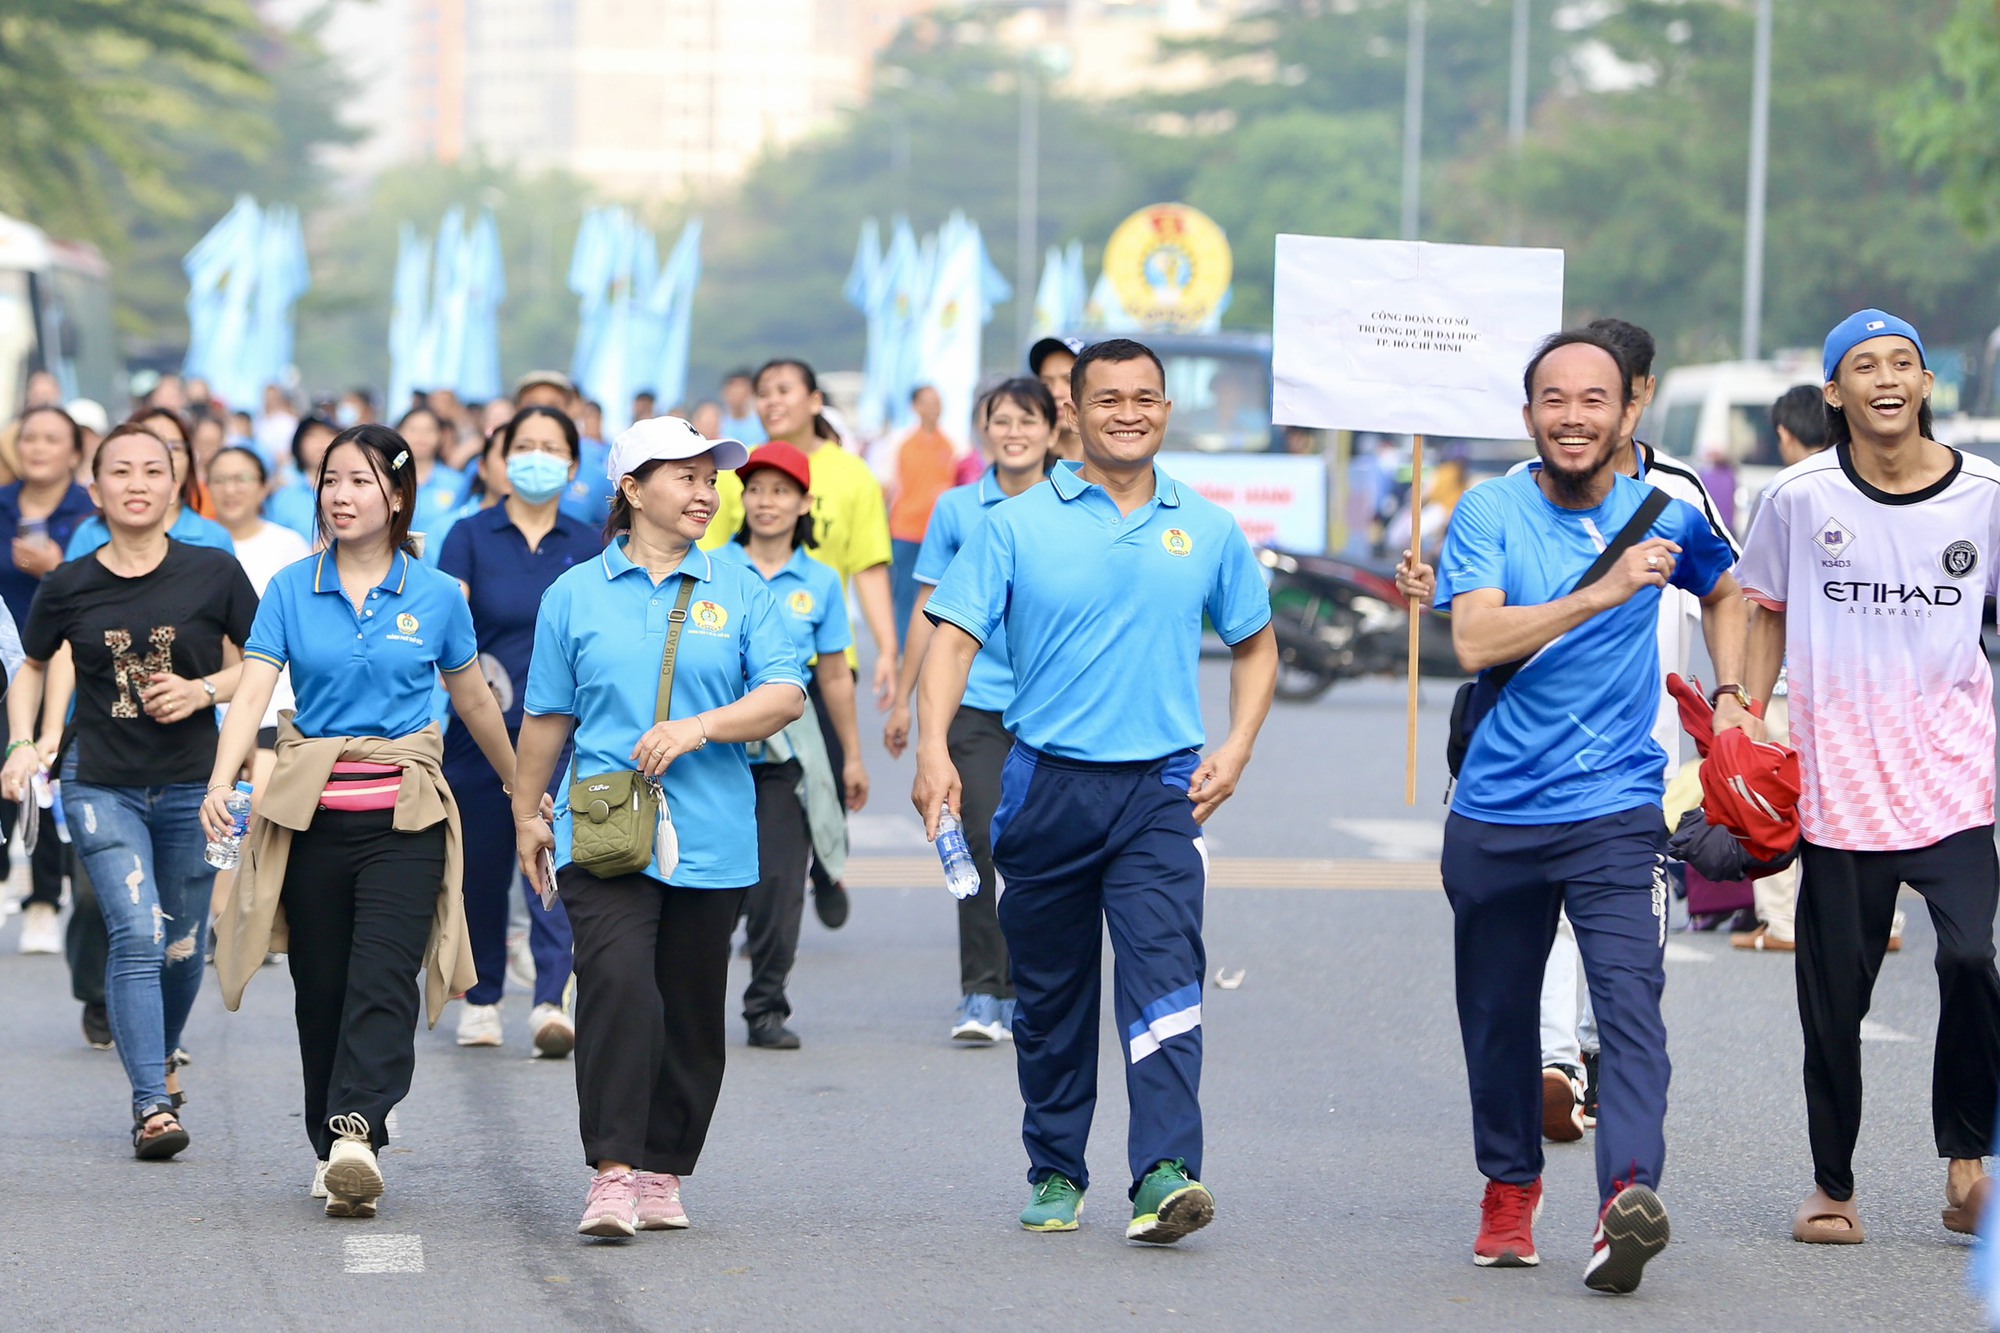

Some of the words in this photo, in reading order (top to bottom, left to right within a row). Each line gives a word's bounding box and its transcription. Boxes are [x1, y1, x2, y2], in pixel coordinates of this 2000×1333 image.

[1371, 310, 1402, 322] CÔNG
[1404, 313, 1434, 324] ĐOÀN
[1436, 316, 1453, 325] CƠ
[1357, 323, 1403, 336] TRƯỜNG
[1423, 330, 1434, 340] BỊ
[1458, 332, 1482, 343] HỌC
[1375, 338, 1391, 347] TP.
[1393, 338, 1409, 349] HỒ
[1411, 340, 1430, 351] CHÍ
[1433, 343, 1462, 353] MINH
[1821, 560, 1852, 568] K34D3
[1823, 581, 1963, 606] ETIHAD
[1847, 605, 1933, 619] AIRWAYS
[661, 630, 679, 676] CHIBAO
[104, 625, 176, 719] M
